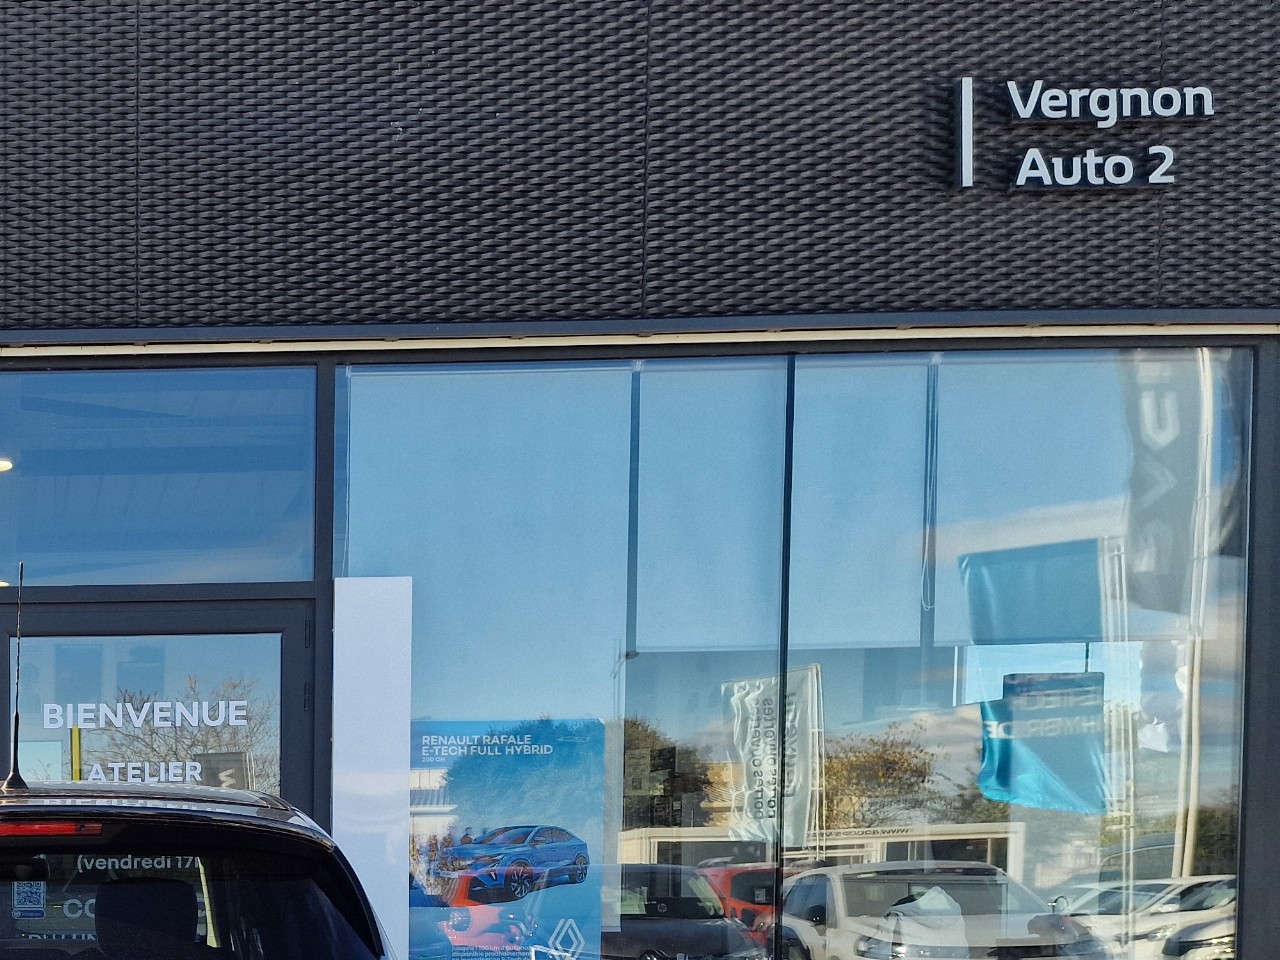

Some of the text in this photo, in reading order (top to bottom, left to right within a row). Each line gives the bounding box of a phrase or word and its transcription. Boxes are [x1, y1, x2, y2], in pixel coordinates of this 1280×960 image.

[1007, 79, 1214, 129] Vergnon
[1016, 145, 1175, 185] Auto 2
[43, 701, 248, 729] BIENVENUE
[422, 735, 532, 745] RENAULT RAFALE
[422, 745, 553, 756] E-TECH FULL HYBRID
[88, 762, 202, 782] ATELIER
[77, 855, 171, 873] (vendredi
